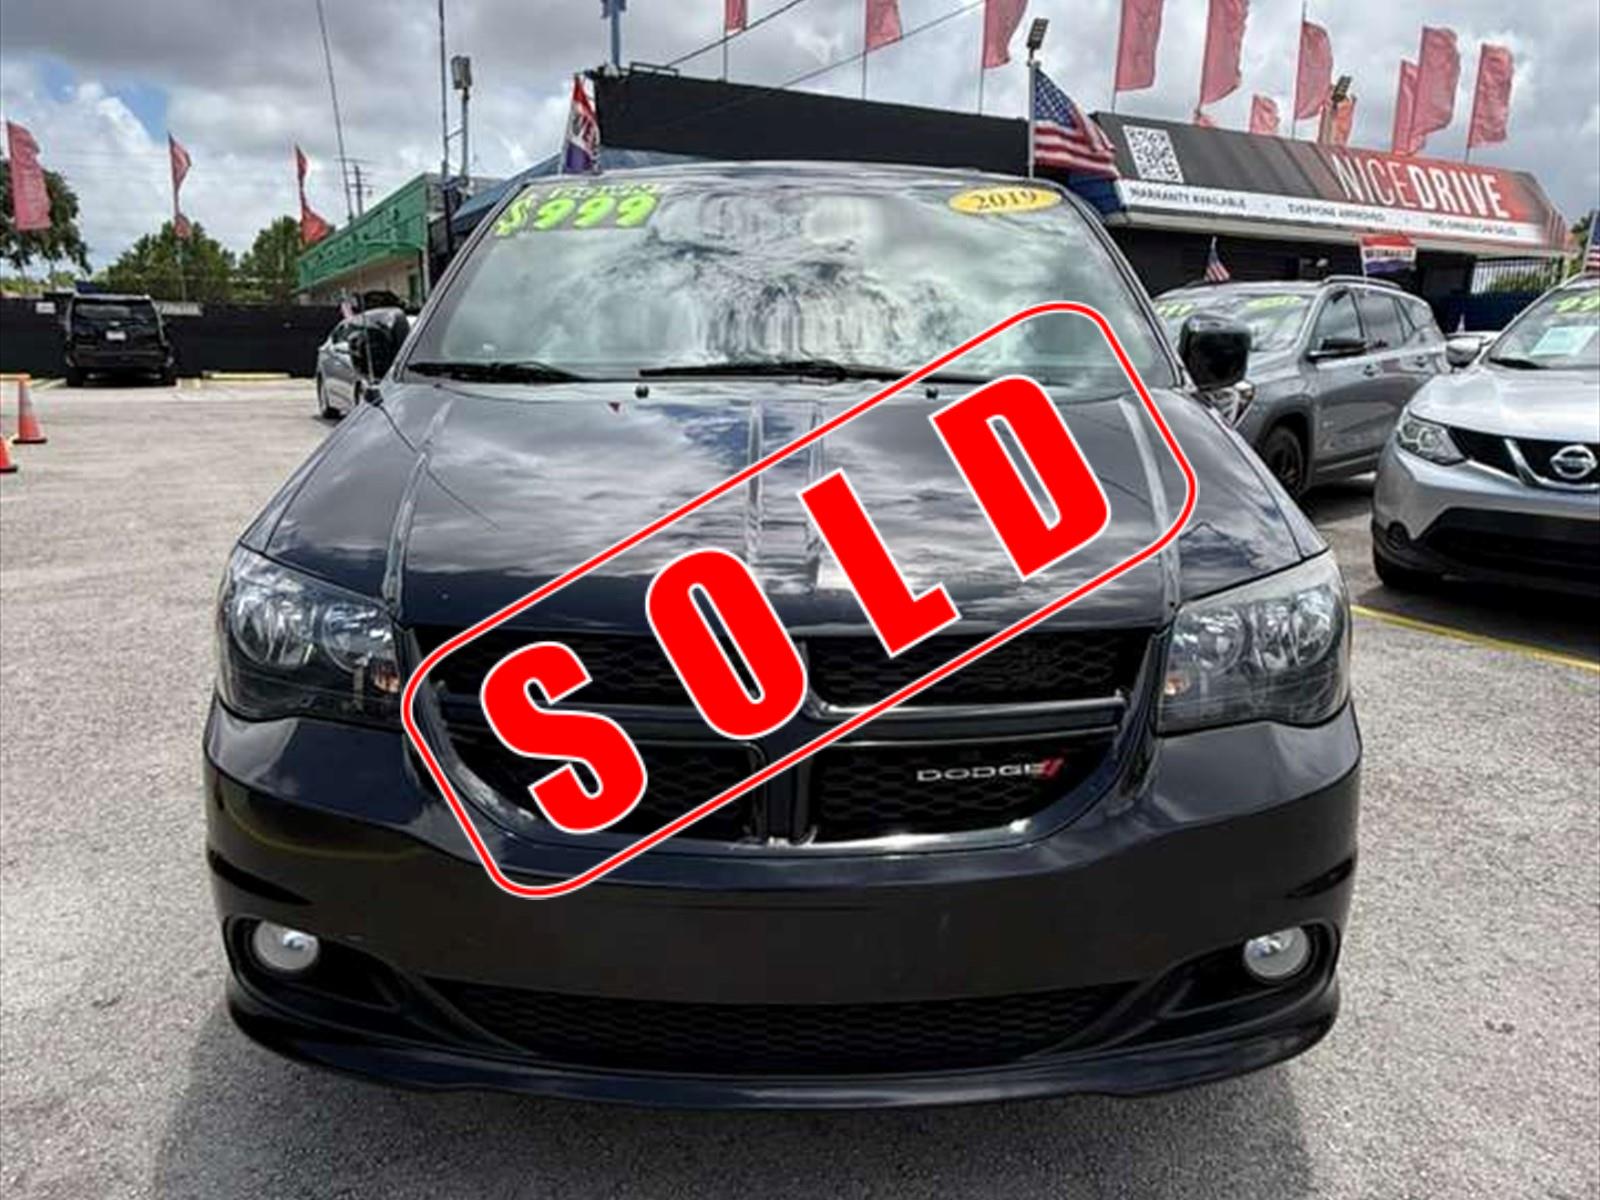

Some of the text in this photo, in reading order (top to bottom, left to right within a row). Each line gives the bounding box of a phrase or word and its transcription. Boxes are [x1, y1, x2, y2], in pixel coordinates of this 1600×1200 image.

[970, 190, 1038, 211] 2019
[494, 194, 656, 236] $999
[916, 762, 1044, 782] DODGE
